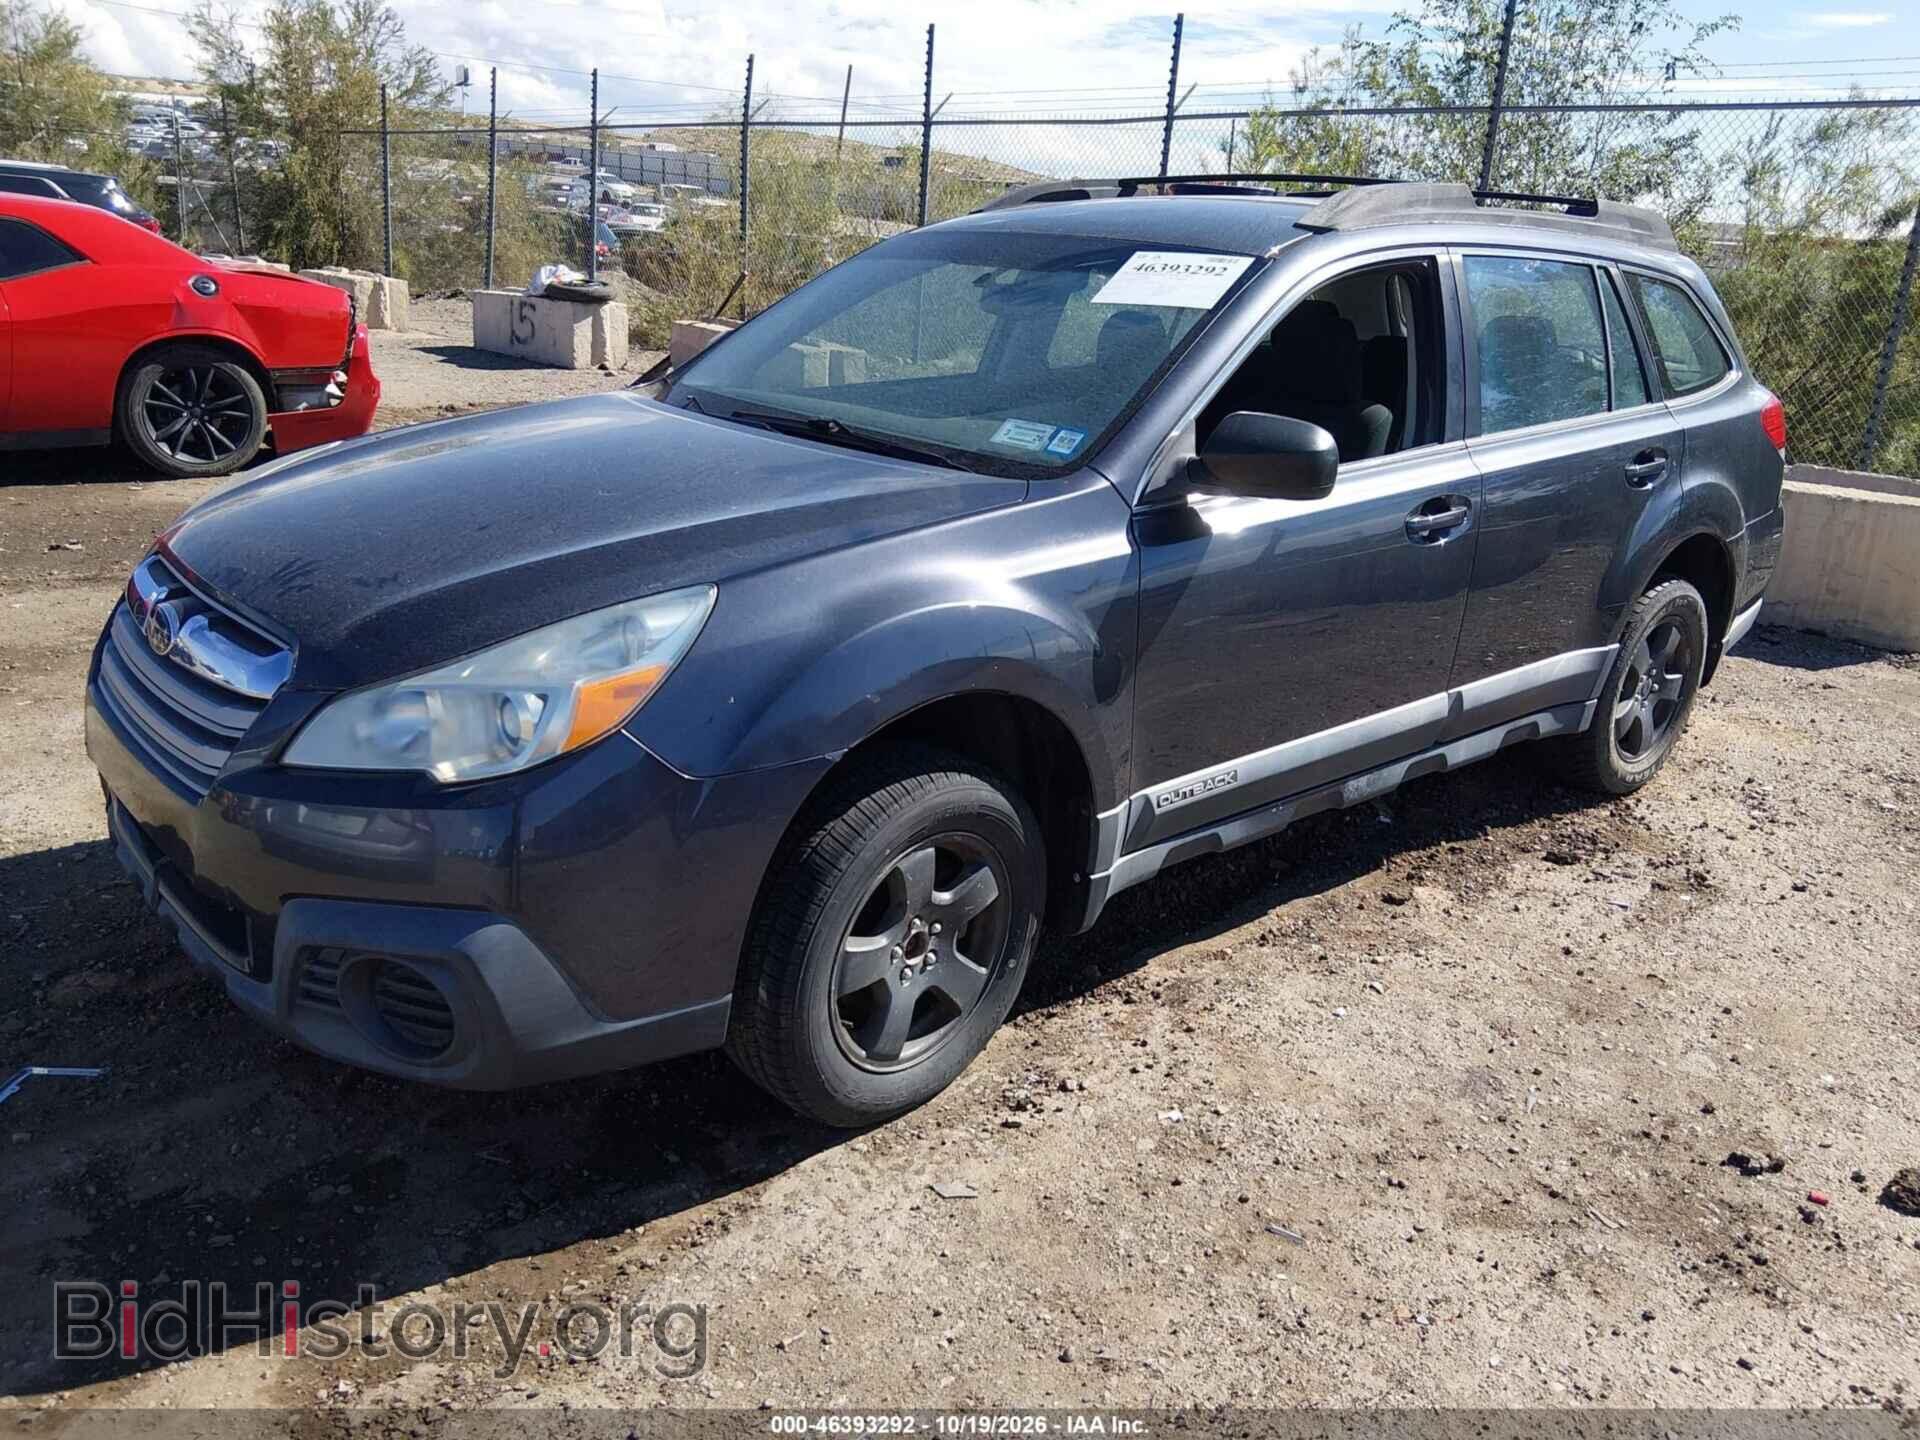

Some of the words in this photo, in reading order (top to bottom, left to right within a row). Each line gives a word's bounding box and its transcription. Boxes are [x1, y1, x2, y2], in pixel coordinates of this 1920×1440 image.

[1133, 263, 1228, 276] 46393292
[510, 299, 536, 345] 15
[1159, 771, 1236, 807] OUTBACK
